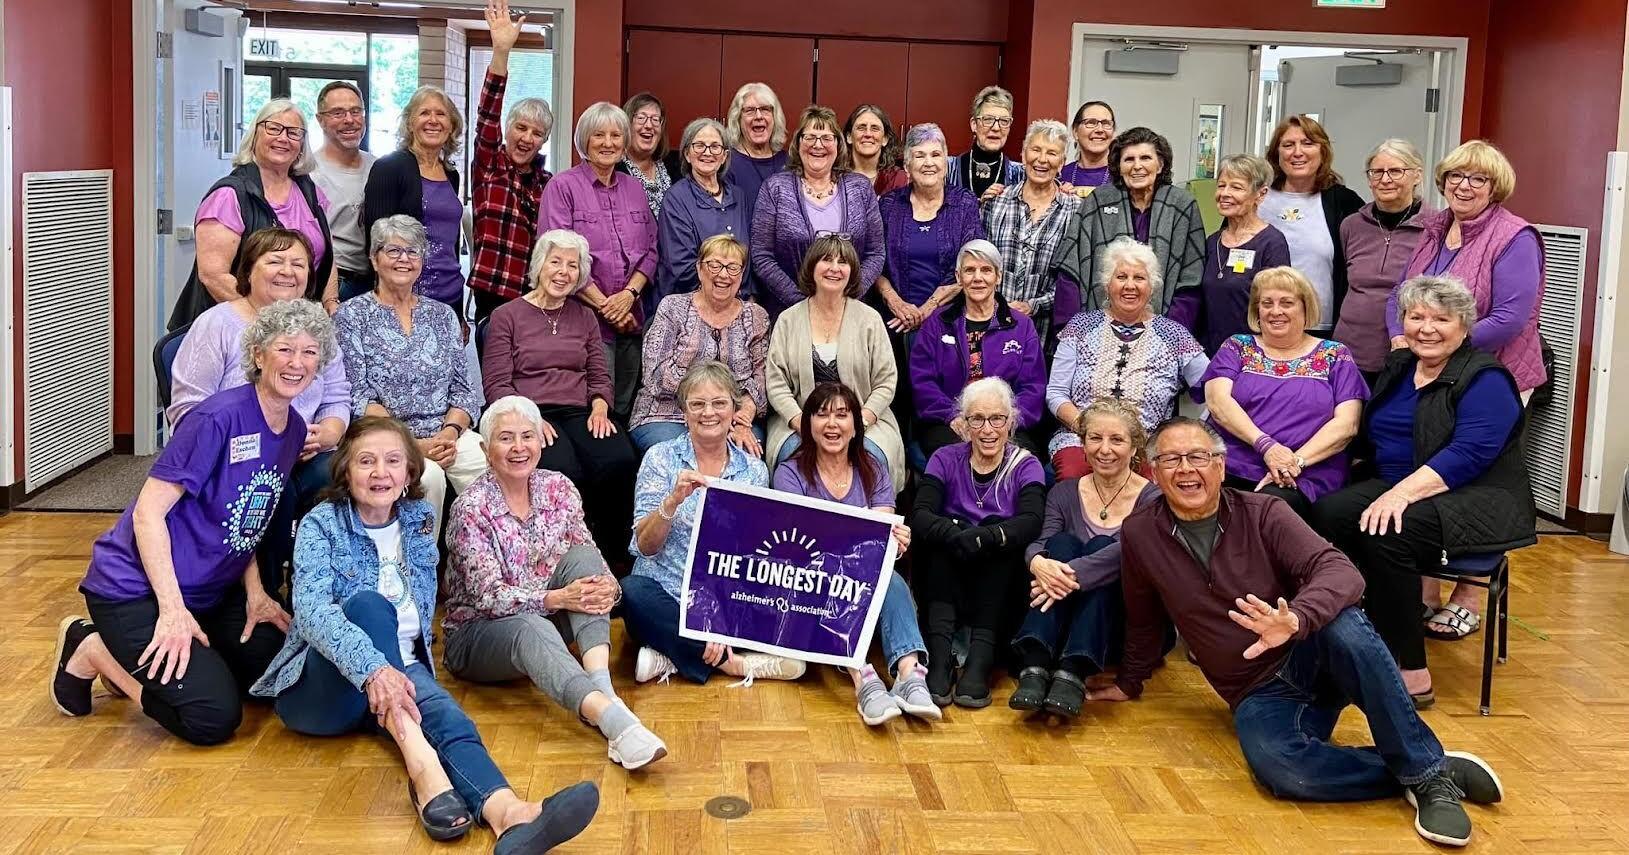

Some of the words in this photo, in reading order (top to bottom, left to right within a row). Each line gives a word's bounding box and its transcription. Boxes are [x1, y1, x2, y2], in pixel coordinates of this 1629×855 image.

[251, 40, 276, 55] EXIT
[707, 551, 742, 578] THE
[746, 558, 828, 594] LONGEST
[829, 575, 867, 604] DAY
[731, 591, 775, 607] alzheimer's
